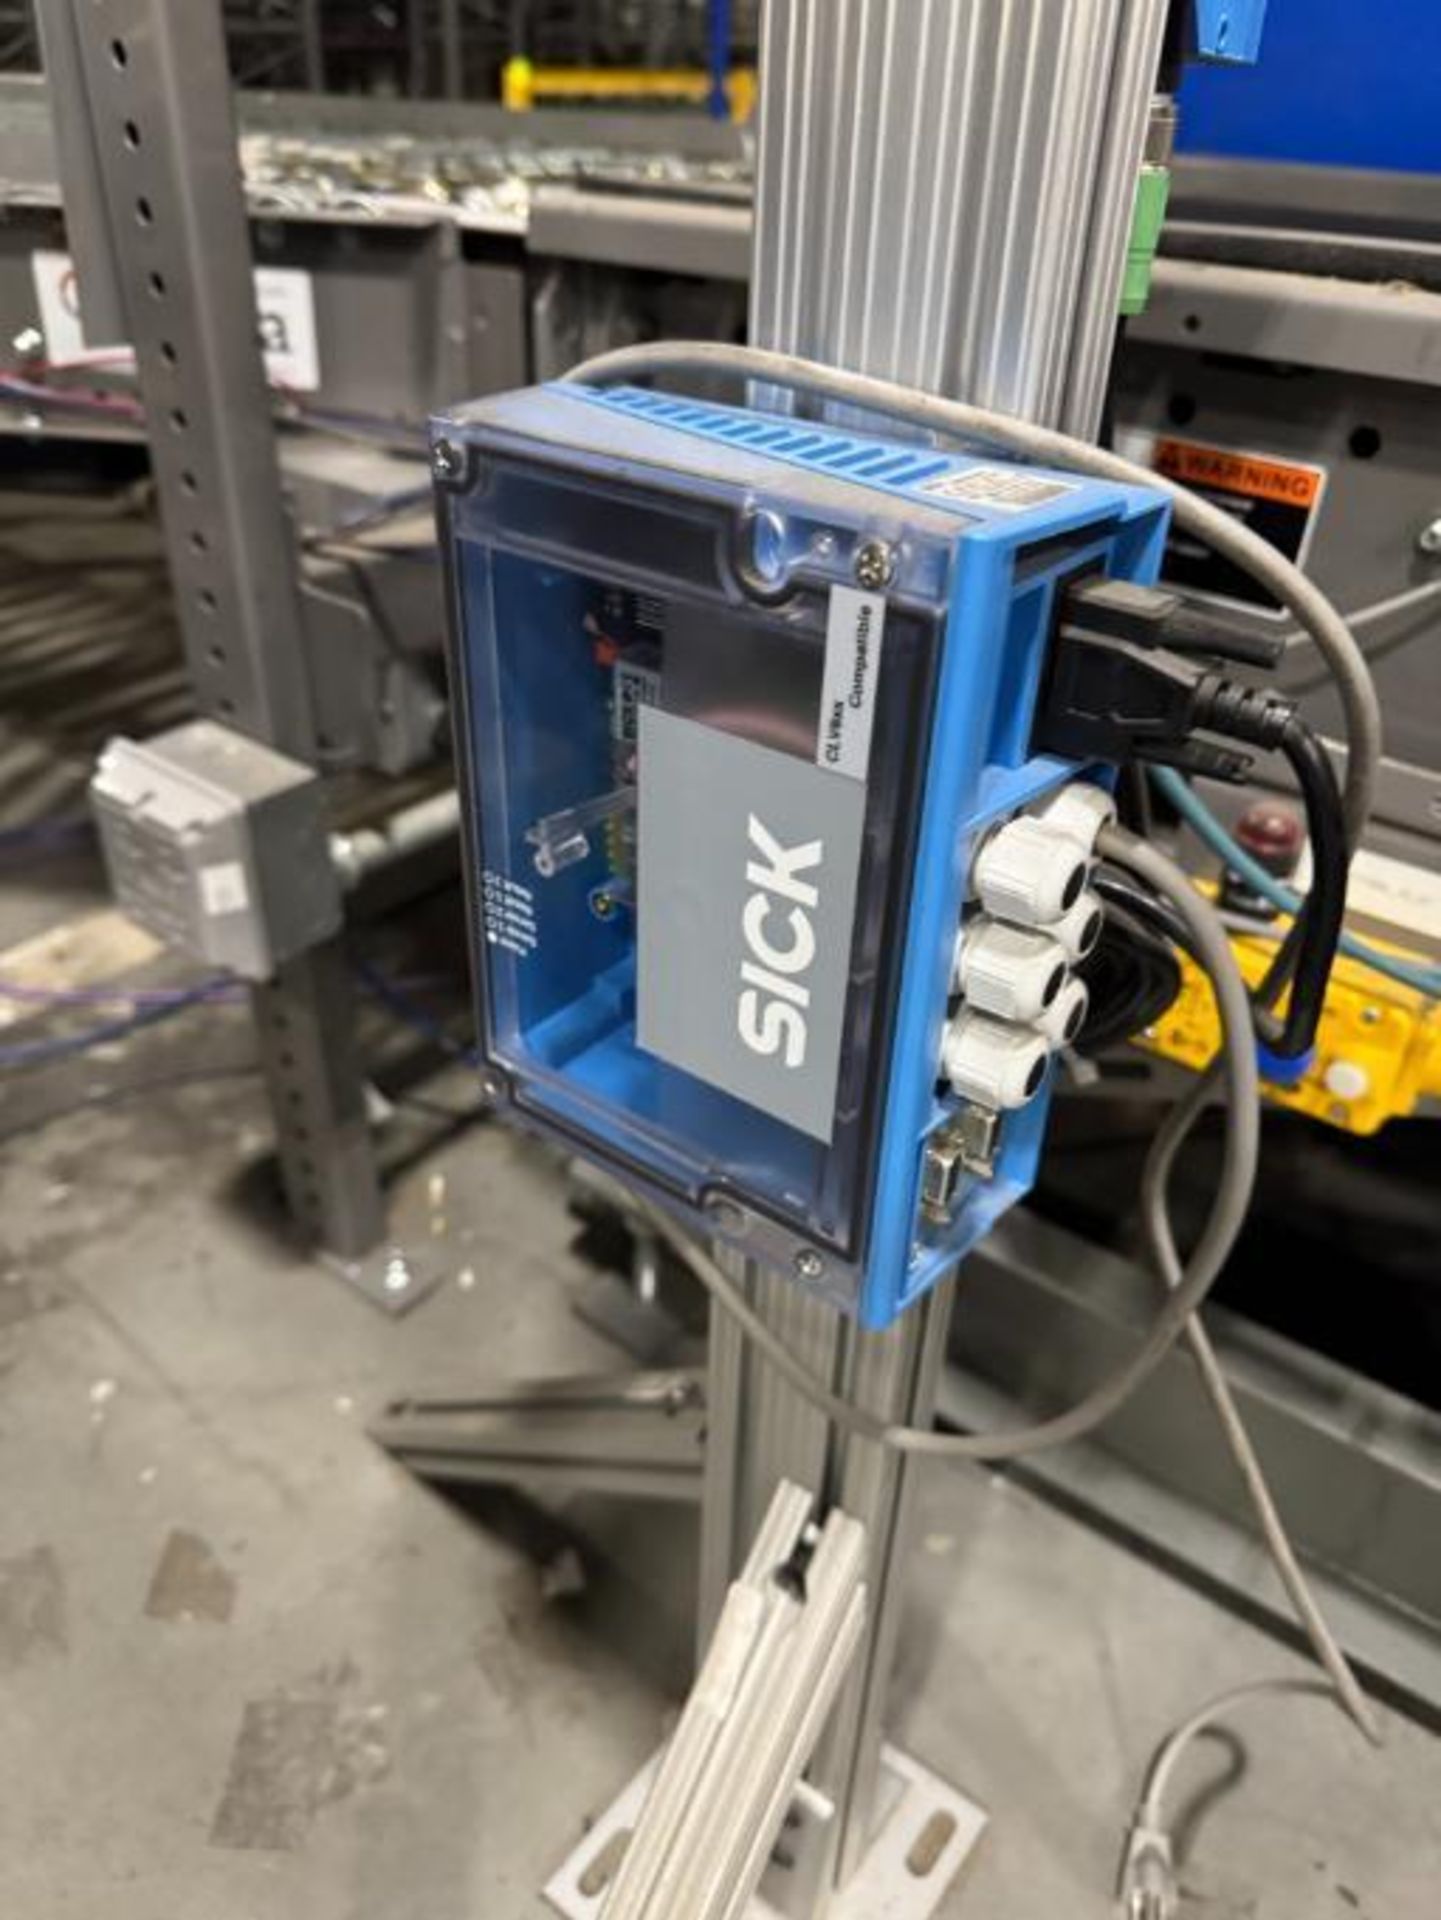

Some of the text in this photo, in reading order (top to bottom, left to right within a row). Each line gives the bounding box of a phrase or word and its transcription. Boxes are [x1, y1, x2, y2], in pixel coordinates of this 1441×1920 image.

[1182, 455, 1311, 497] WARNING
[849, 605, 872, 709] Compatible
[738, 813, 823, 1067] SICK
